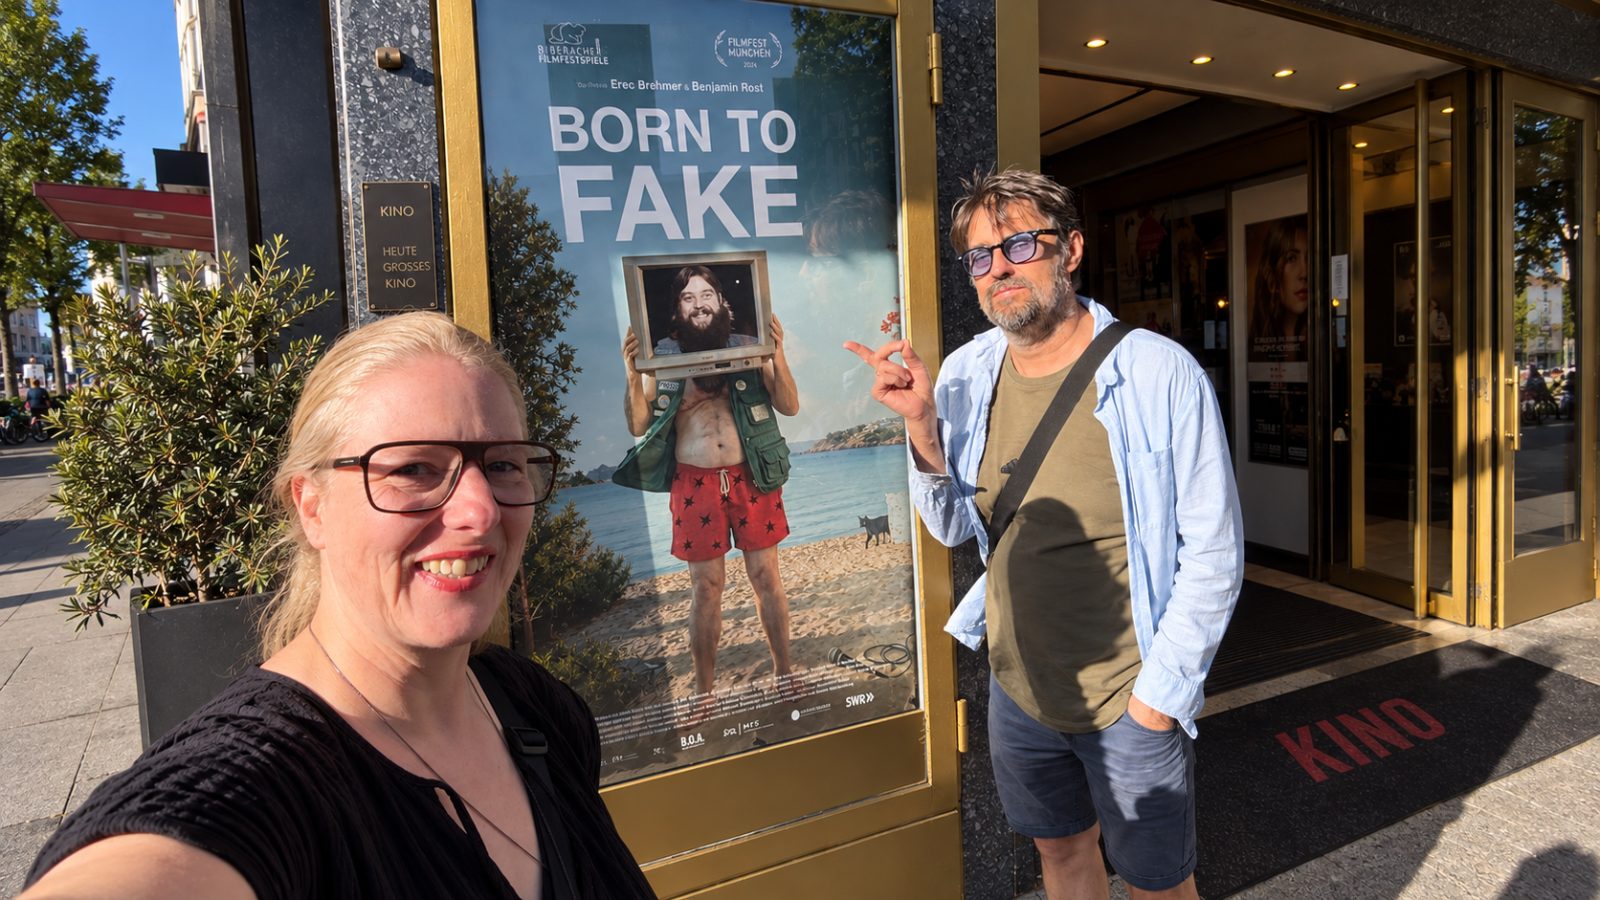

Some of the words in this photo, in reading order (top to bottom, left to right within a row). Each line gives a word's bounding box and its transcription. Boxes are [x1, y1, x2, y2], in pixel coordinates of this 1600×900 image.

[728, 37, 767, 48] FILMFEST
[538, 54, 609, 65] FILMFESTSPIELE
[610, 79, 635, 90] Erec
[638, 79, 683, 91] Brehmer
[691, 81, 738, 93] Benjamin
[741, 82, 764, 93] Rost
[548, 105, 712, 153] BORN
[726, 109, 796, 154] TO
[558, 165, 803, 243] FAKE
[380, 205, 415, 217] KINO
[383, 246, 417, 257] HEUTE
[383, 261, 431, 273] GROSSES
[385, 278, 416, 289] KINO
[845, 694, 867, 708] SWR
[1275, 698, 1445, 783] KINO
